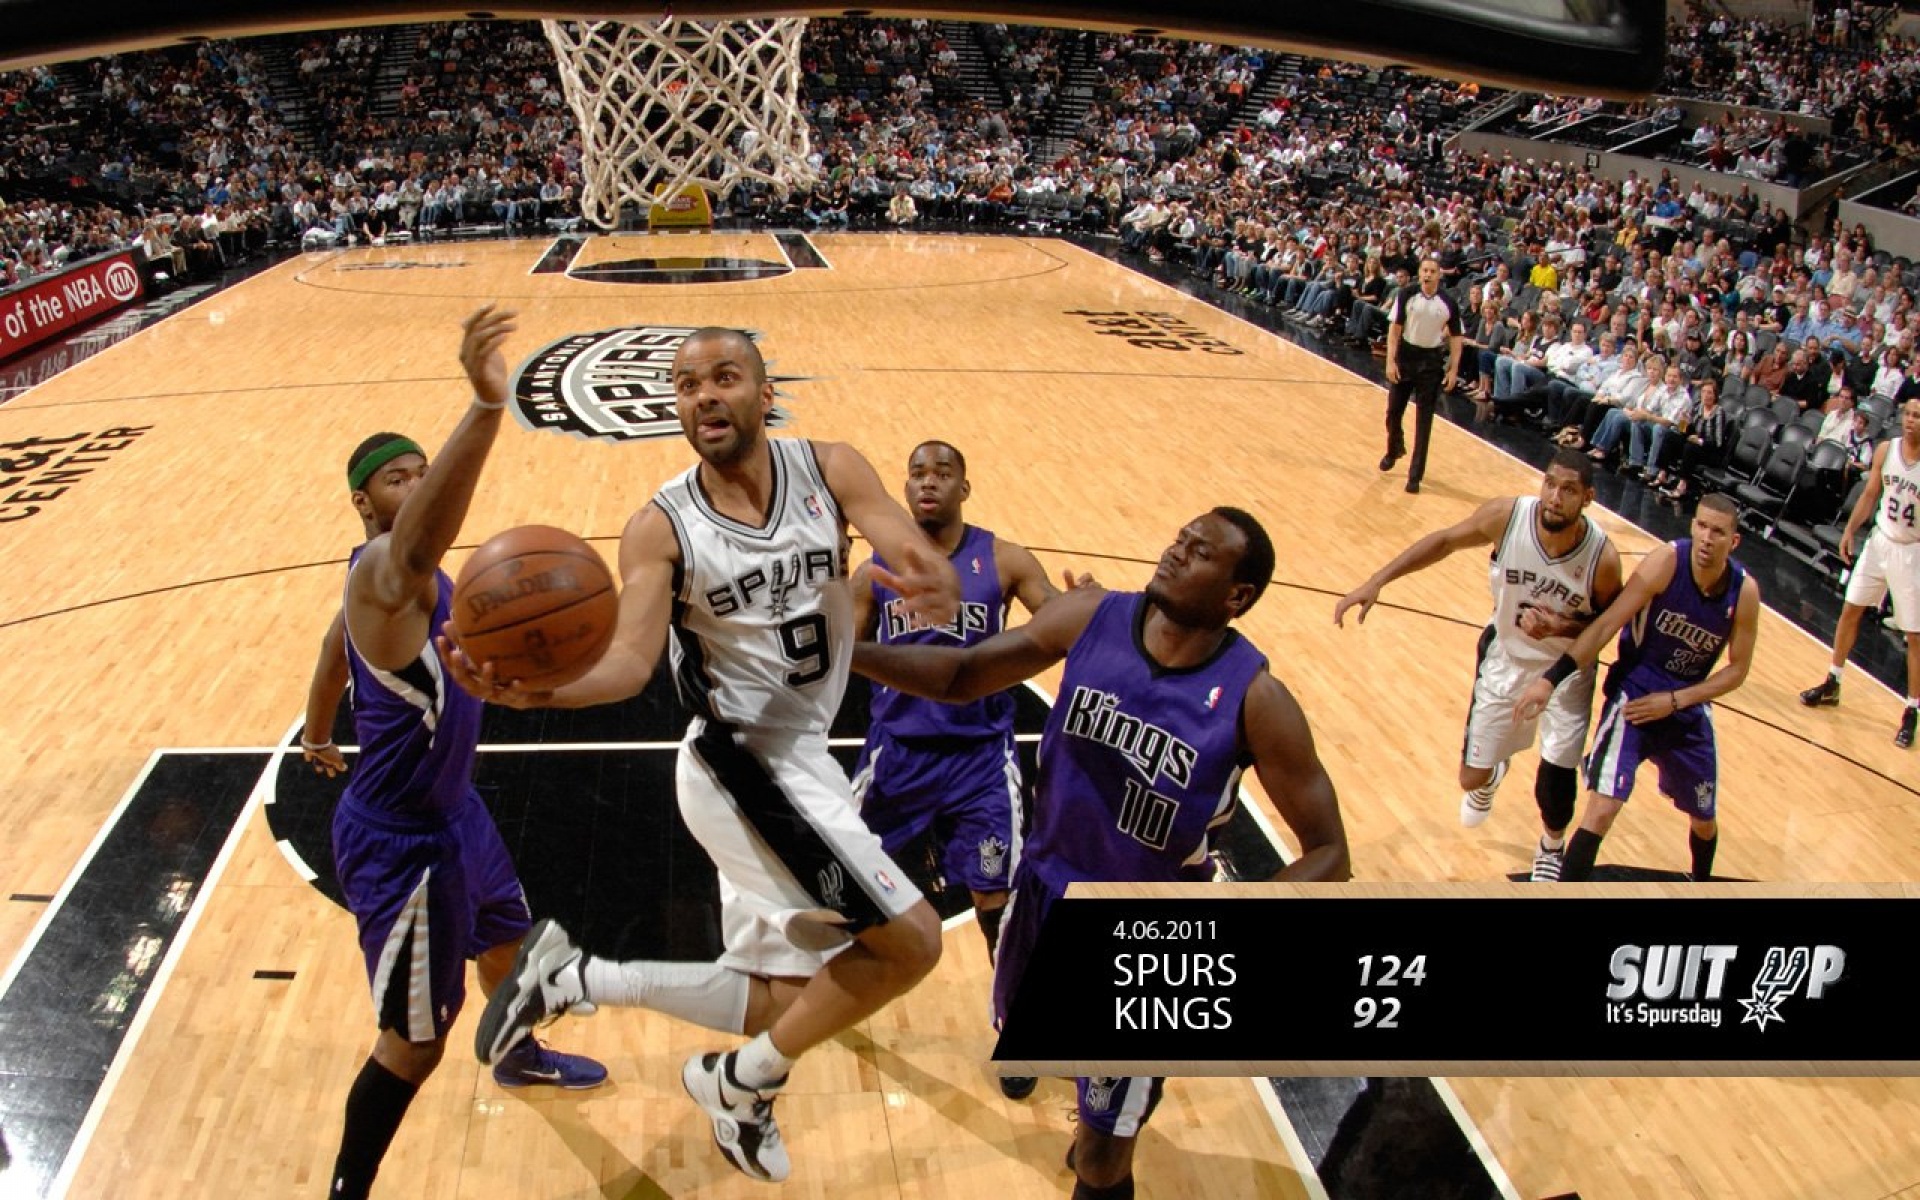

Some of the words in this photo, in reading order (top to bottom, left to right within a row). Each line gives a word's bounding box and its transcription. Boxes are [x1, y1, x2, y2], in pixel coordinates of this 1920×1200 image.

[5, 301, 27, 338] of
[29, 294, 64, 327] the
[63, 274, 105, 312] NBA
[110, 269, 134, 294] KIA
[531, 337, 595, 388] ANTONIO
[531, 391, 567, 422] SAN
[0, 432, 92, 488] &t
[0, 425, 154, 522] CENTER
[1887, 497, 1915, 527] 24
[1506, 569, 1584, 607] SPURS
[884, 598, 988, 641] Kgs
[1655, 608, 1722, 652] Kings
[778, 612, 831, 687] 9
[1063, 685, 1199, 790] Kings
[1117, 777, 1180, 851] 10
